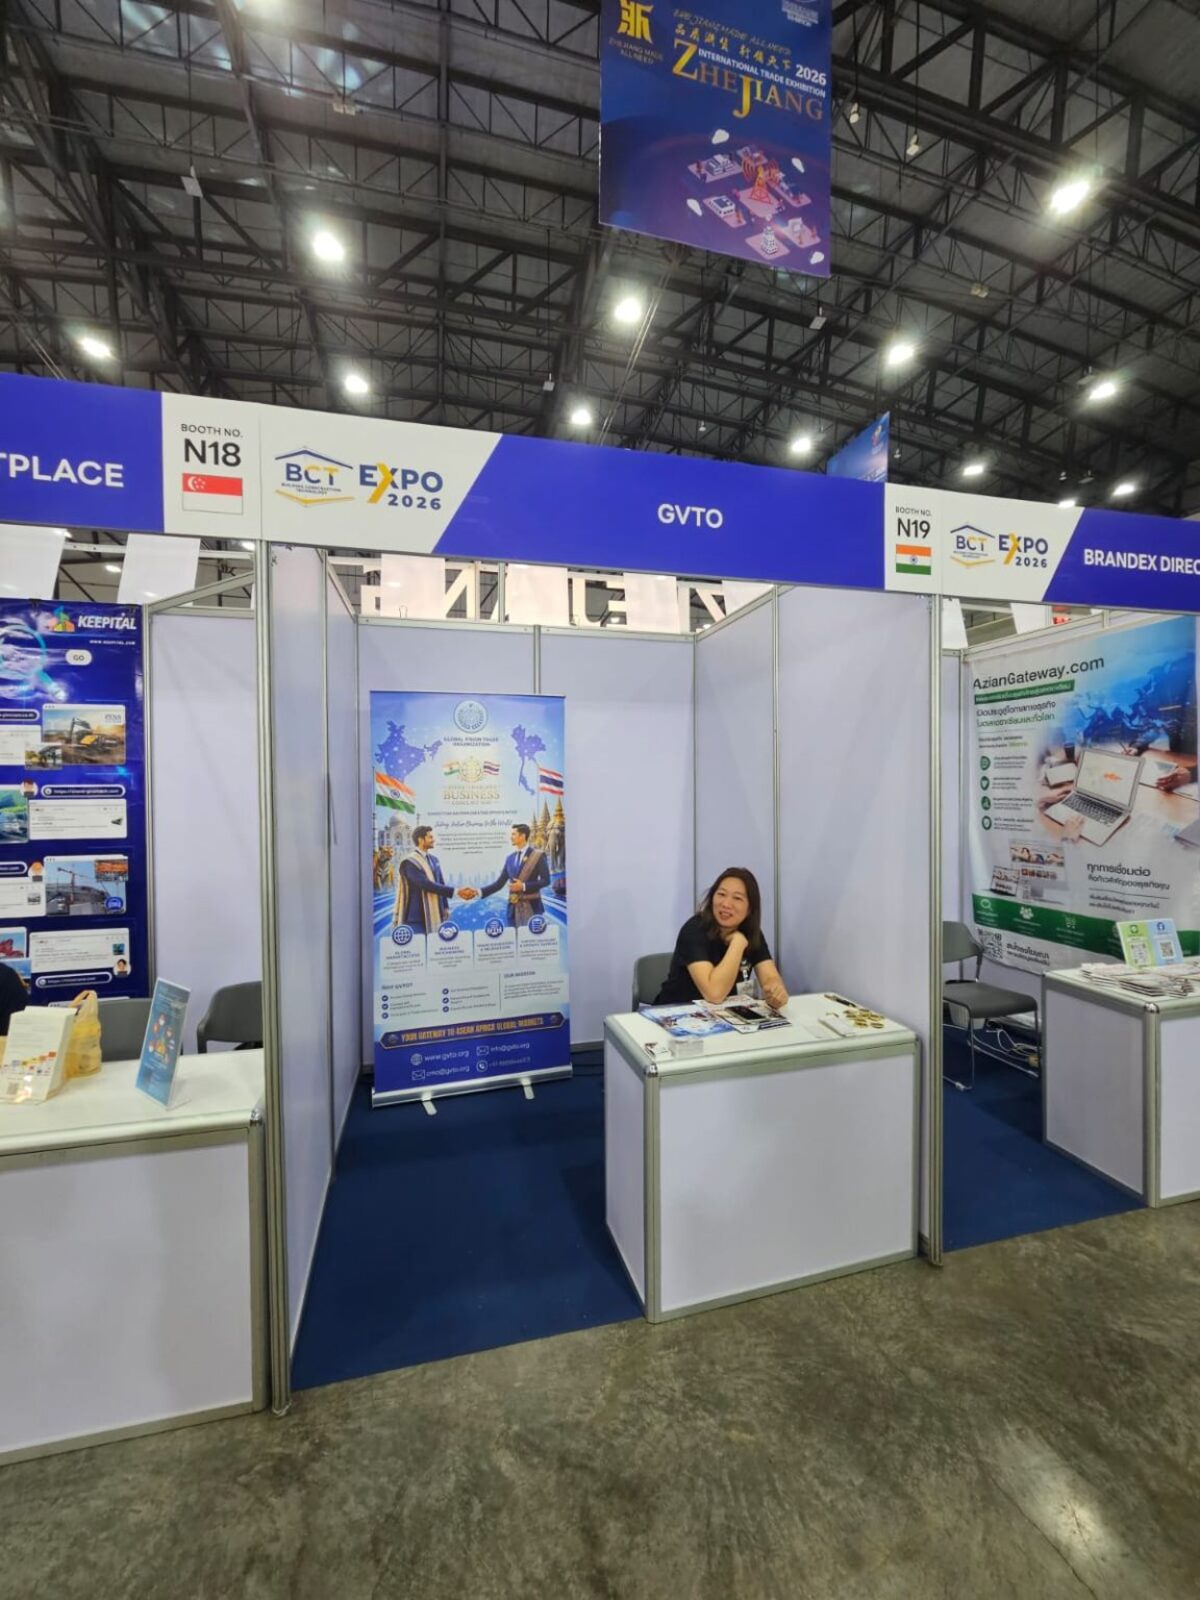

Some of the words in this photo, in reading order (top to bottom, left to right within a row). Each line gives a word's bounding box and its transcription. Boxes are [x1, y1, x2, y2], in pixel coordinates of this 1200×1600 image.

[698, 48, 758, 76] INTERNATIONAL
[760, 68, 784, 85] TRADE
[785, 79, 826, 98] EXHIBITION
[795, 63, 827, 86] 2026
[181, 423, 221, 437] BOOTH
[223, 428, 243, 439] NO.
[184, 438, 241, 467] N18
[286, 463, 339, 486] BCT
[359, 461, 444, 502] EXPO
[388, 494, 442, 510] 2026
[657, 503, 723, 529] GVTO
[897, 517, 931, 539] N19
[956, 535, 988, 552] BCT
[998, 532, 1048, 563] EXPO
[1015, 556, 1047, 568] 2026
[1084, 548, 1157, 571] BRANDEX
[78, 614, 137, 630] KEEPITAL
[73, 654, 85, 663] GO
[973, 657, 1104, 690] AzianGateway.com
